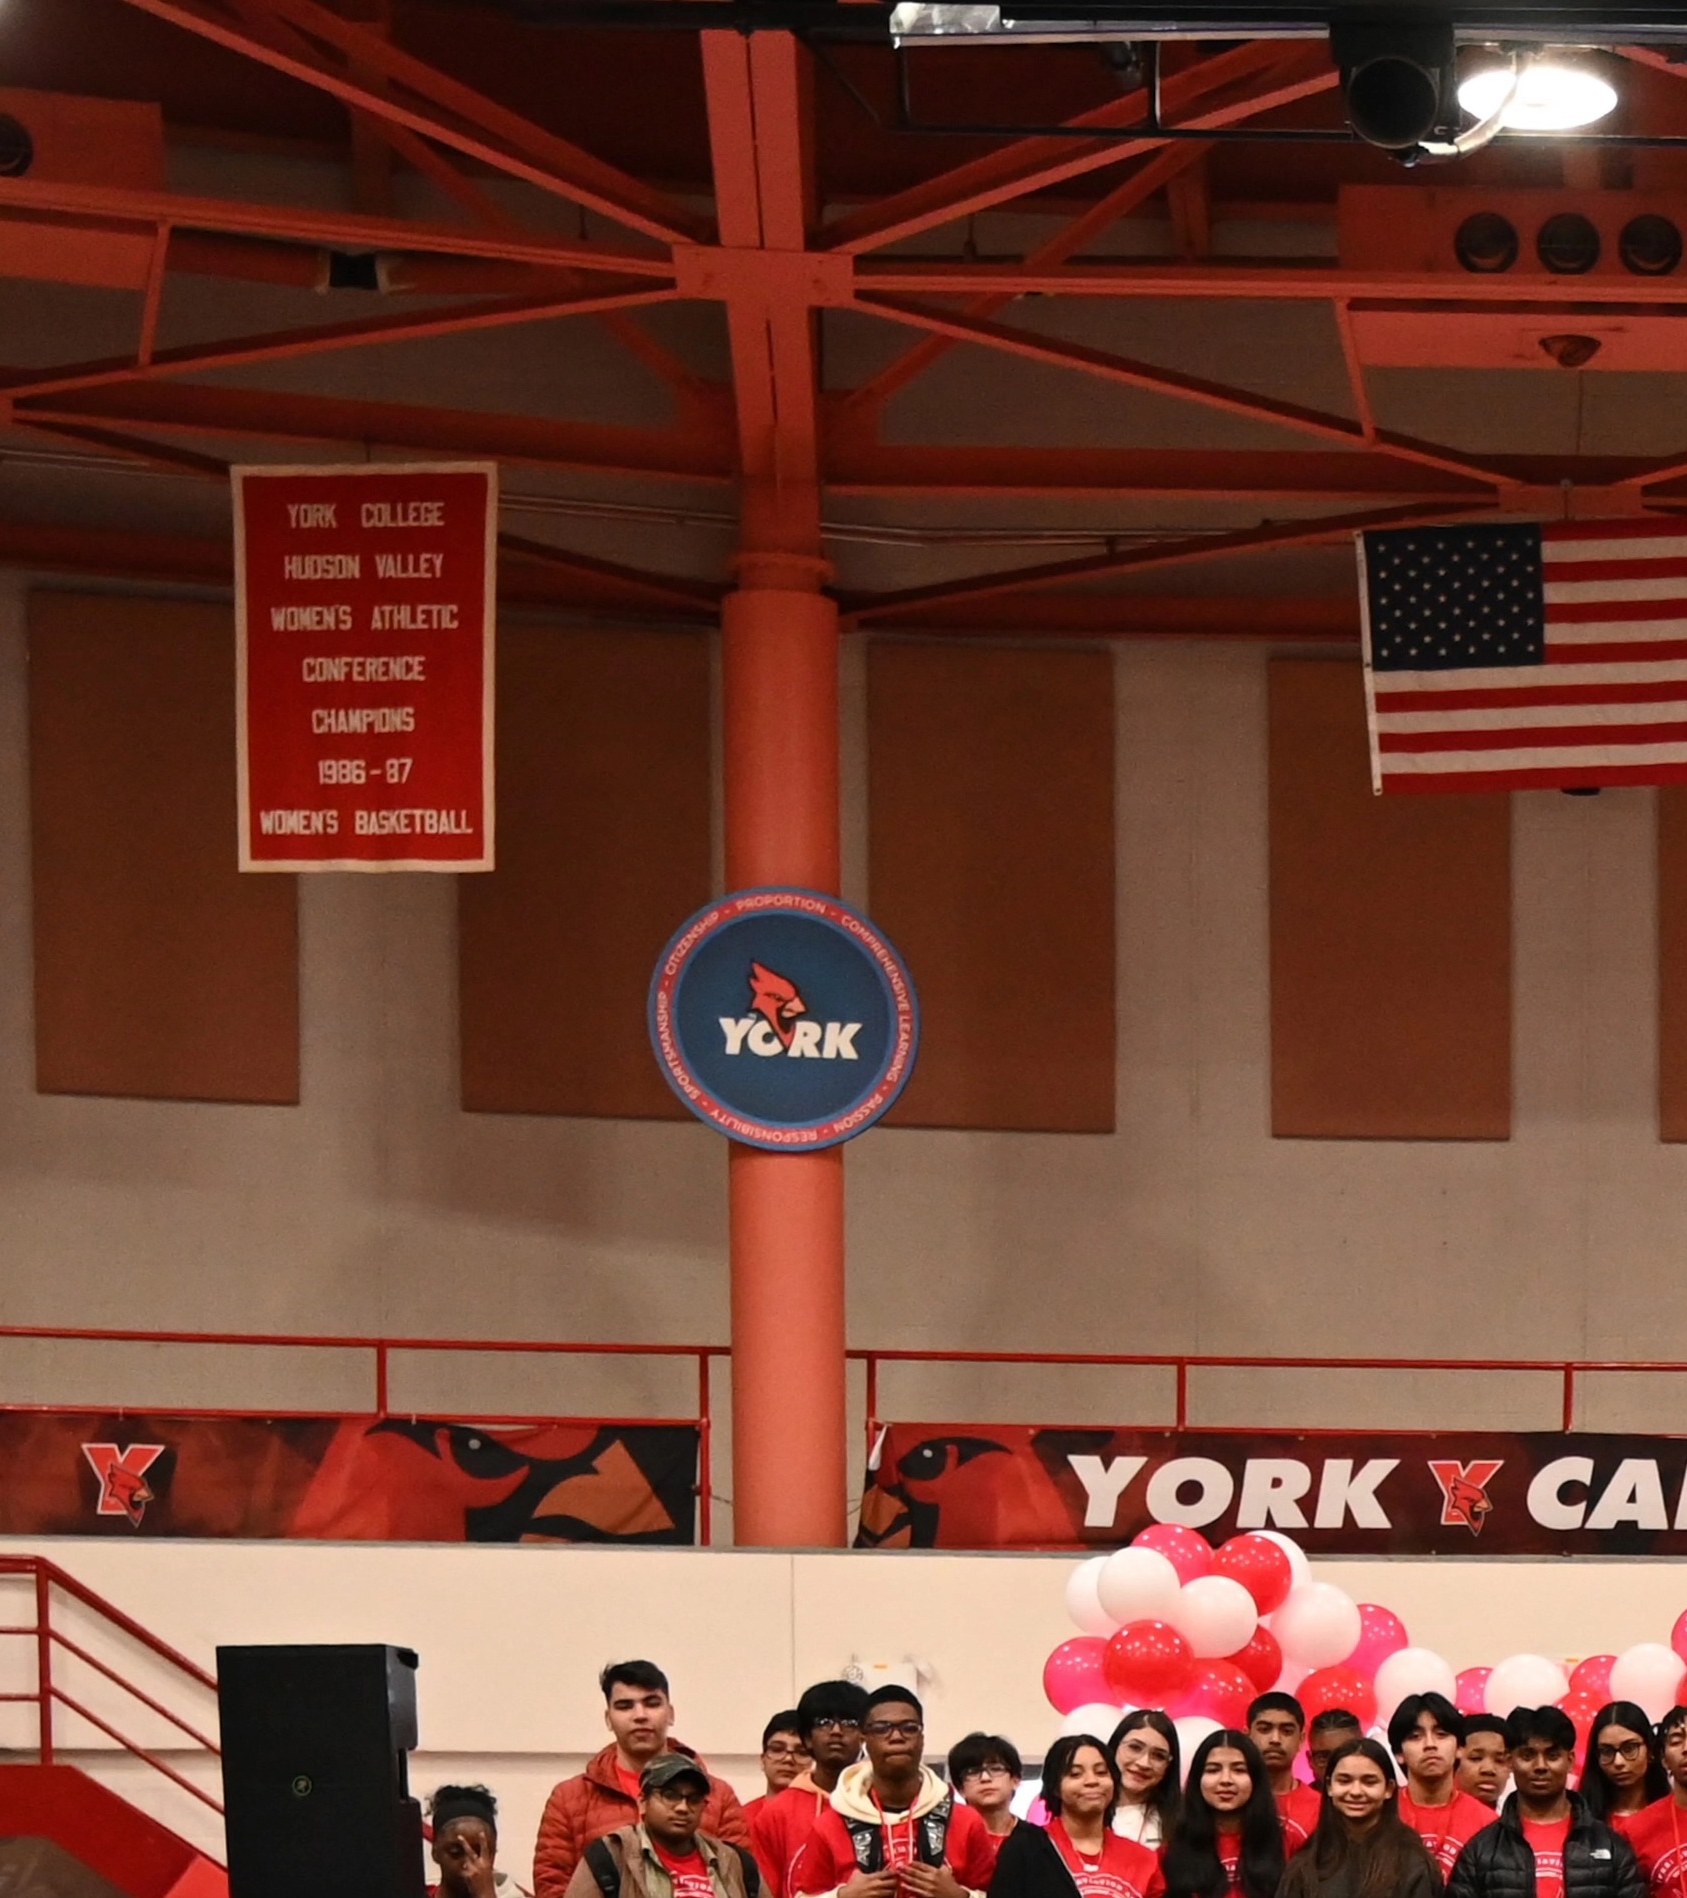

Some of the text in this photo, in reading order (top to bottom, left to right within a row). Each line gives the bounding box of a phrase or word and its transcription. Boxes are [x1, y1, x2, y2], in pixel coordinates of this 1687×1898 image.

[287, 502, 446, 529] YORK COLLEGE
[285, 553, 444, 579] HUDSON VALLEY
[270, 604, 459, 632] WOMEN'S ATHLETIC
[302, 656, 426, 683] CONFERENCE
[311, 707, 415, 734] CHAMPIONS
[260, 810, 473, 836] WOMEN'S BASKETBALL
[657, 895, 911, 1143] PROPORTION COMPREHENSIVE LEARNING PASSION RESPONSIBILITY SPORTSMANSHIP CITIZENSHIP
[718, 1016, 863, 1060] YORK
[1067, 1454, 1402, 1530] YORK
